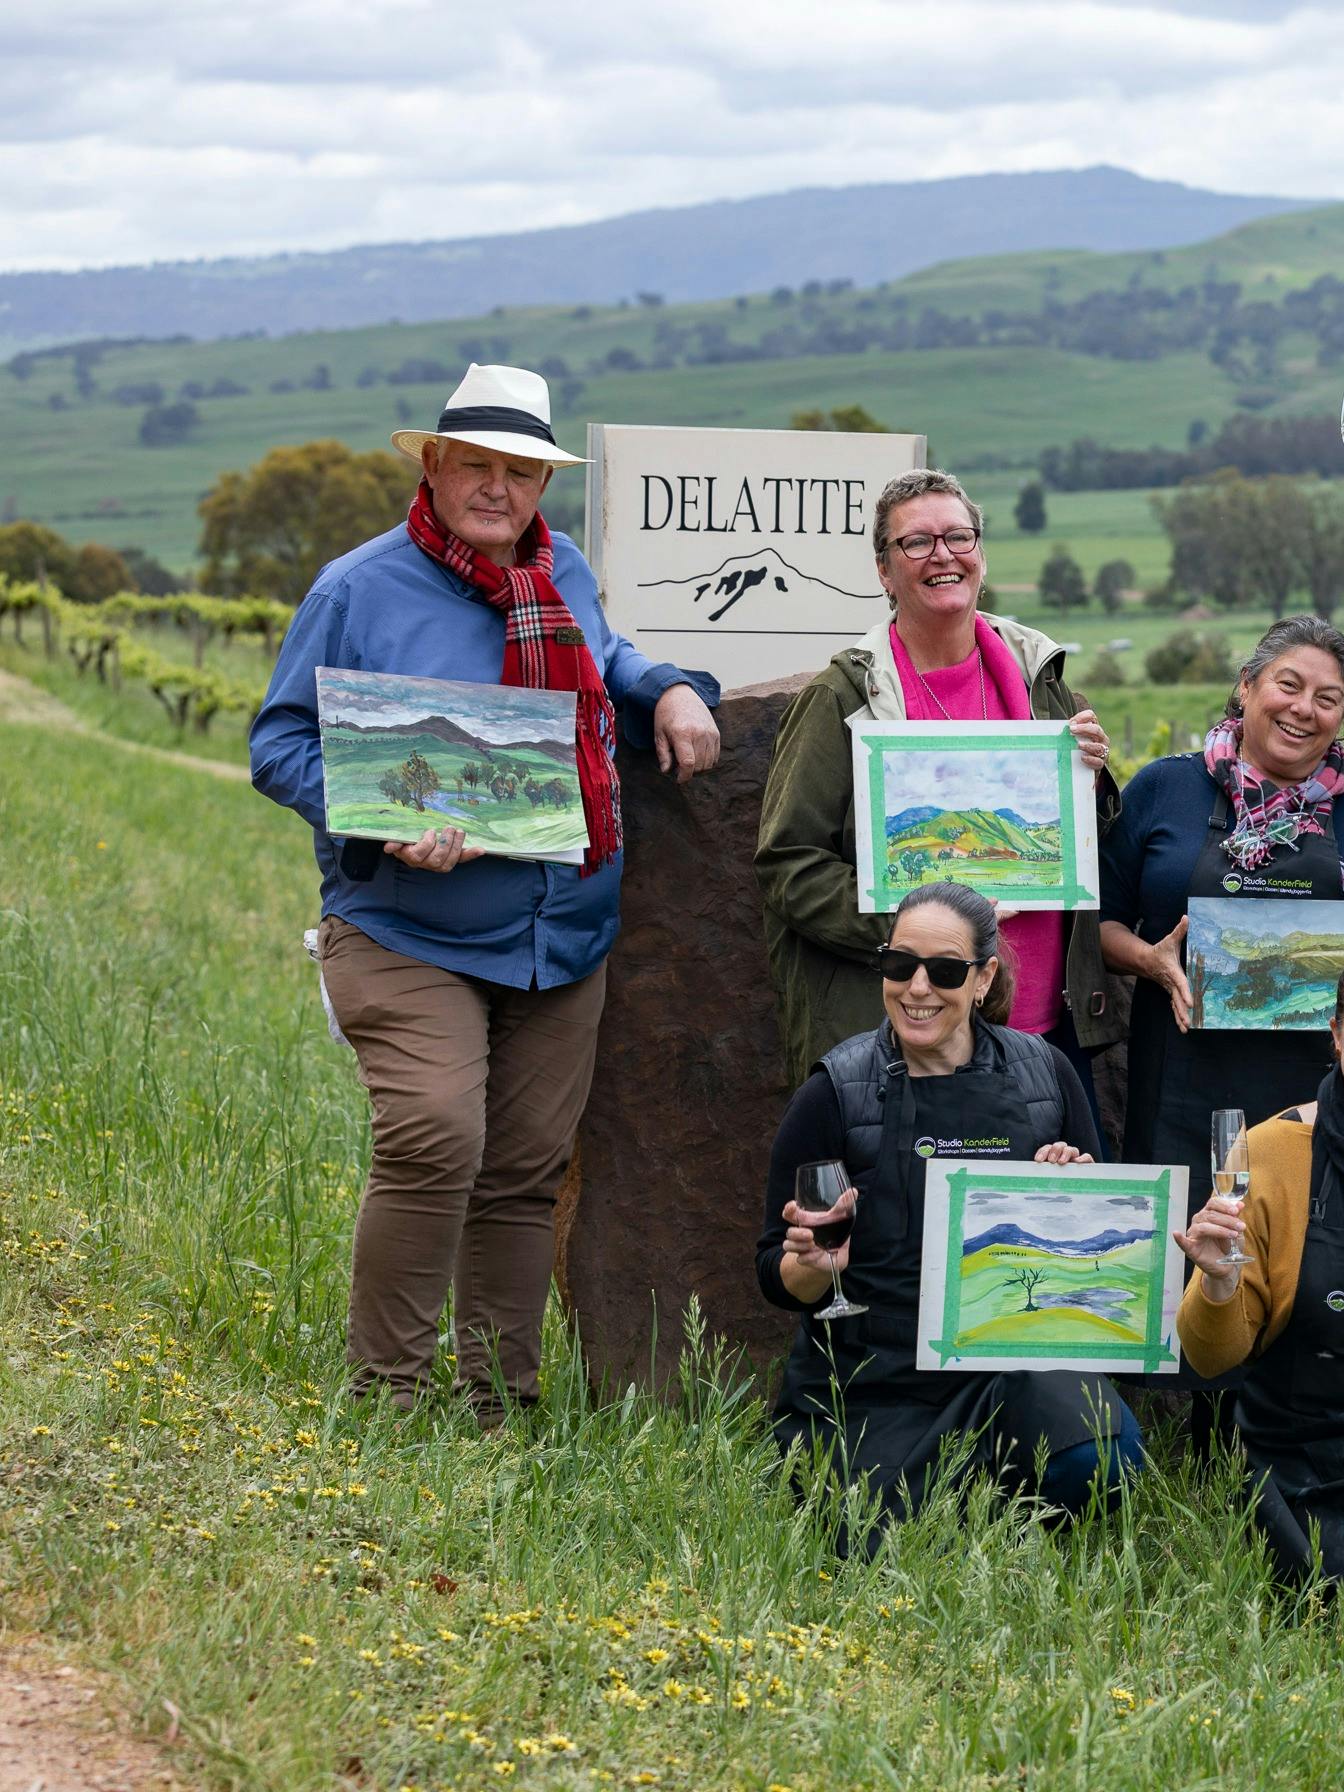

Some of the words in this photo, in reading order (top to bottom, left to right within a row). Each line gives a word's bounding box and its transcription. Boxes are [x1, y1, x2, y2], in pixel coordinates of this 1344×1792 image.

[639, 474, 866, 536] DELATITE
[1243, 876, 1266, 886] Studio
[937, 1138, 963, 1148] Studio
[963, 1137, 1009, 1146] KanderField
